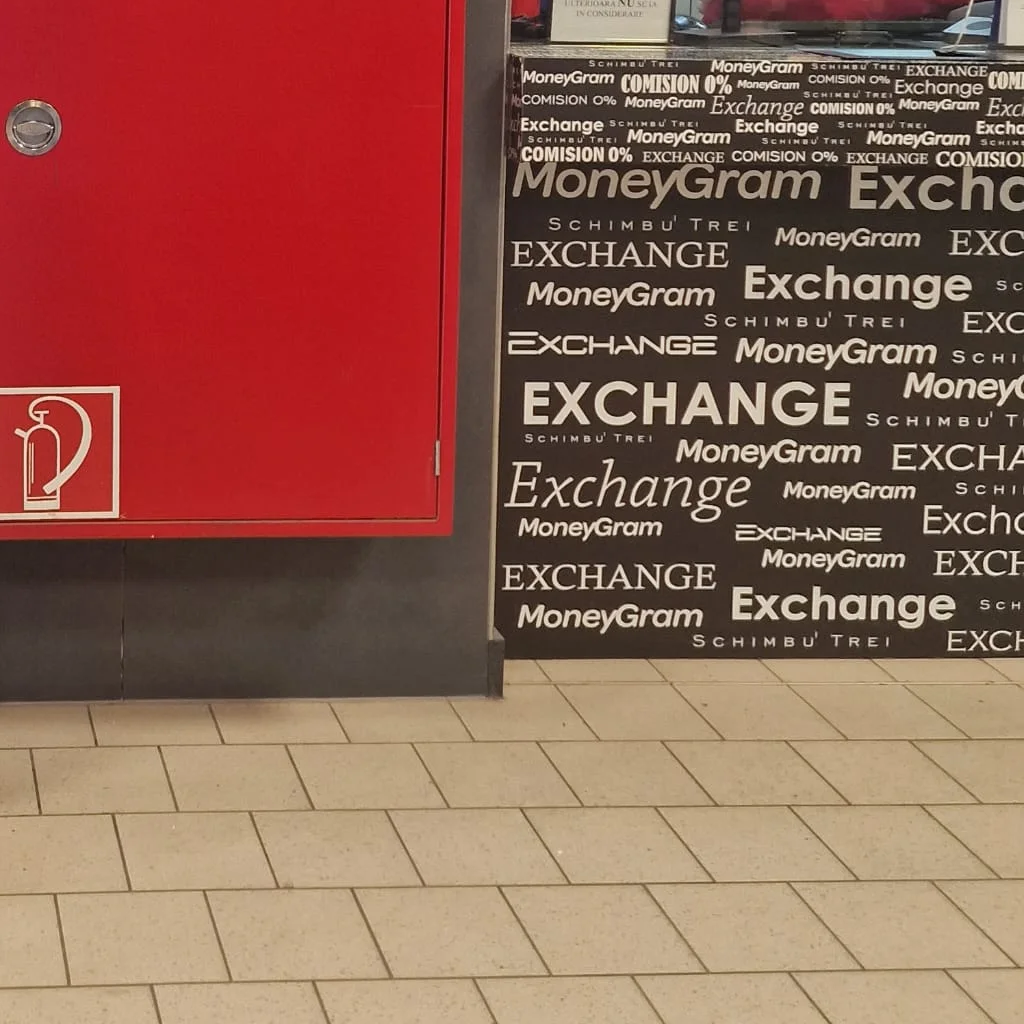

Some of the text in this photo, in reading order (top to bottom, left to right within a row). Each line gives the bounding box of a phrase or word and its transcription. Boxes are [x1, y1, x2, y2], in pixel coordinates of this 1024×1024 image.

[711, 60, 803, 76] MoneyGram
[905, 65, 989, 77] EXCHANGE
[522, 70, 615, 87] MoneyGram
[621, 74, 733, 95] COMISION 0%
[737, 79, 800, 91] MoneyGram
[808, 74, 891, 85] COMISION 0%
[894, 79, 984, 99] Exchange
[521, 94, 617, 106] COMISION 0%
[624, 96, 706, 111] MoneyGram
[709, 94, 805, 122] Exchange
[810, 102, 896, 115] COMISION 0%
[898, 98, 980, 113] MoneyGram
[520, 117, 604, 135] Exchange
[735, 118, 819, 137] Exchange
[627, 129, 731, 147] MoneyGram
[866, 130, 971, 149] MoneyGram
[521, 146, 633, 163] COMISION 0%
[642, 151, 725, 164] EXCHANGE
[731, 150, 838, 163] COMISION 0%
[846, 152, 928, 165] EXCHANGE
[512, 162, 822, 210] MoneyGram
[775, 227, 921, 251] MoneyGram
[510, 240, 729, 268] EXCHANGE
[526, 281, 716, 313] MoneyGram
[744, 264, 973, 310] Exchange
[507, 331, 718, 356] EXCHANGE
[735, 337, 938, 371] MoneyGram
[523, 380, 851, 426] EXCHANGE
[675, 438, 862, 470] MoneyGram
[504, 458, 752, 523] Exchange
[783, 481, 916, 504] MoneyGram
[518, 517, 663, 542] MoneyGram
[735, 524, 883, 542] EXCHANGE
[761, 548, 906, 573] MoneyGram
[501, 564, 716, 591] EXCHANGE
[732, 585, 957, 629] Exchange
[517, 603, 704, 634] MoneyGram
